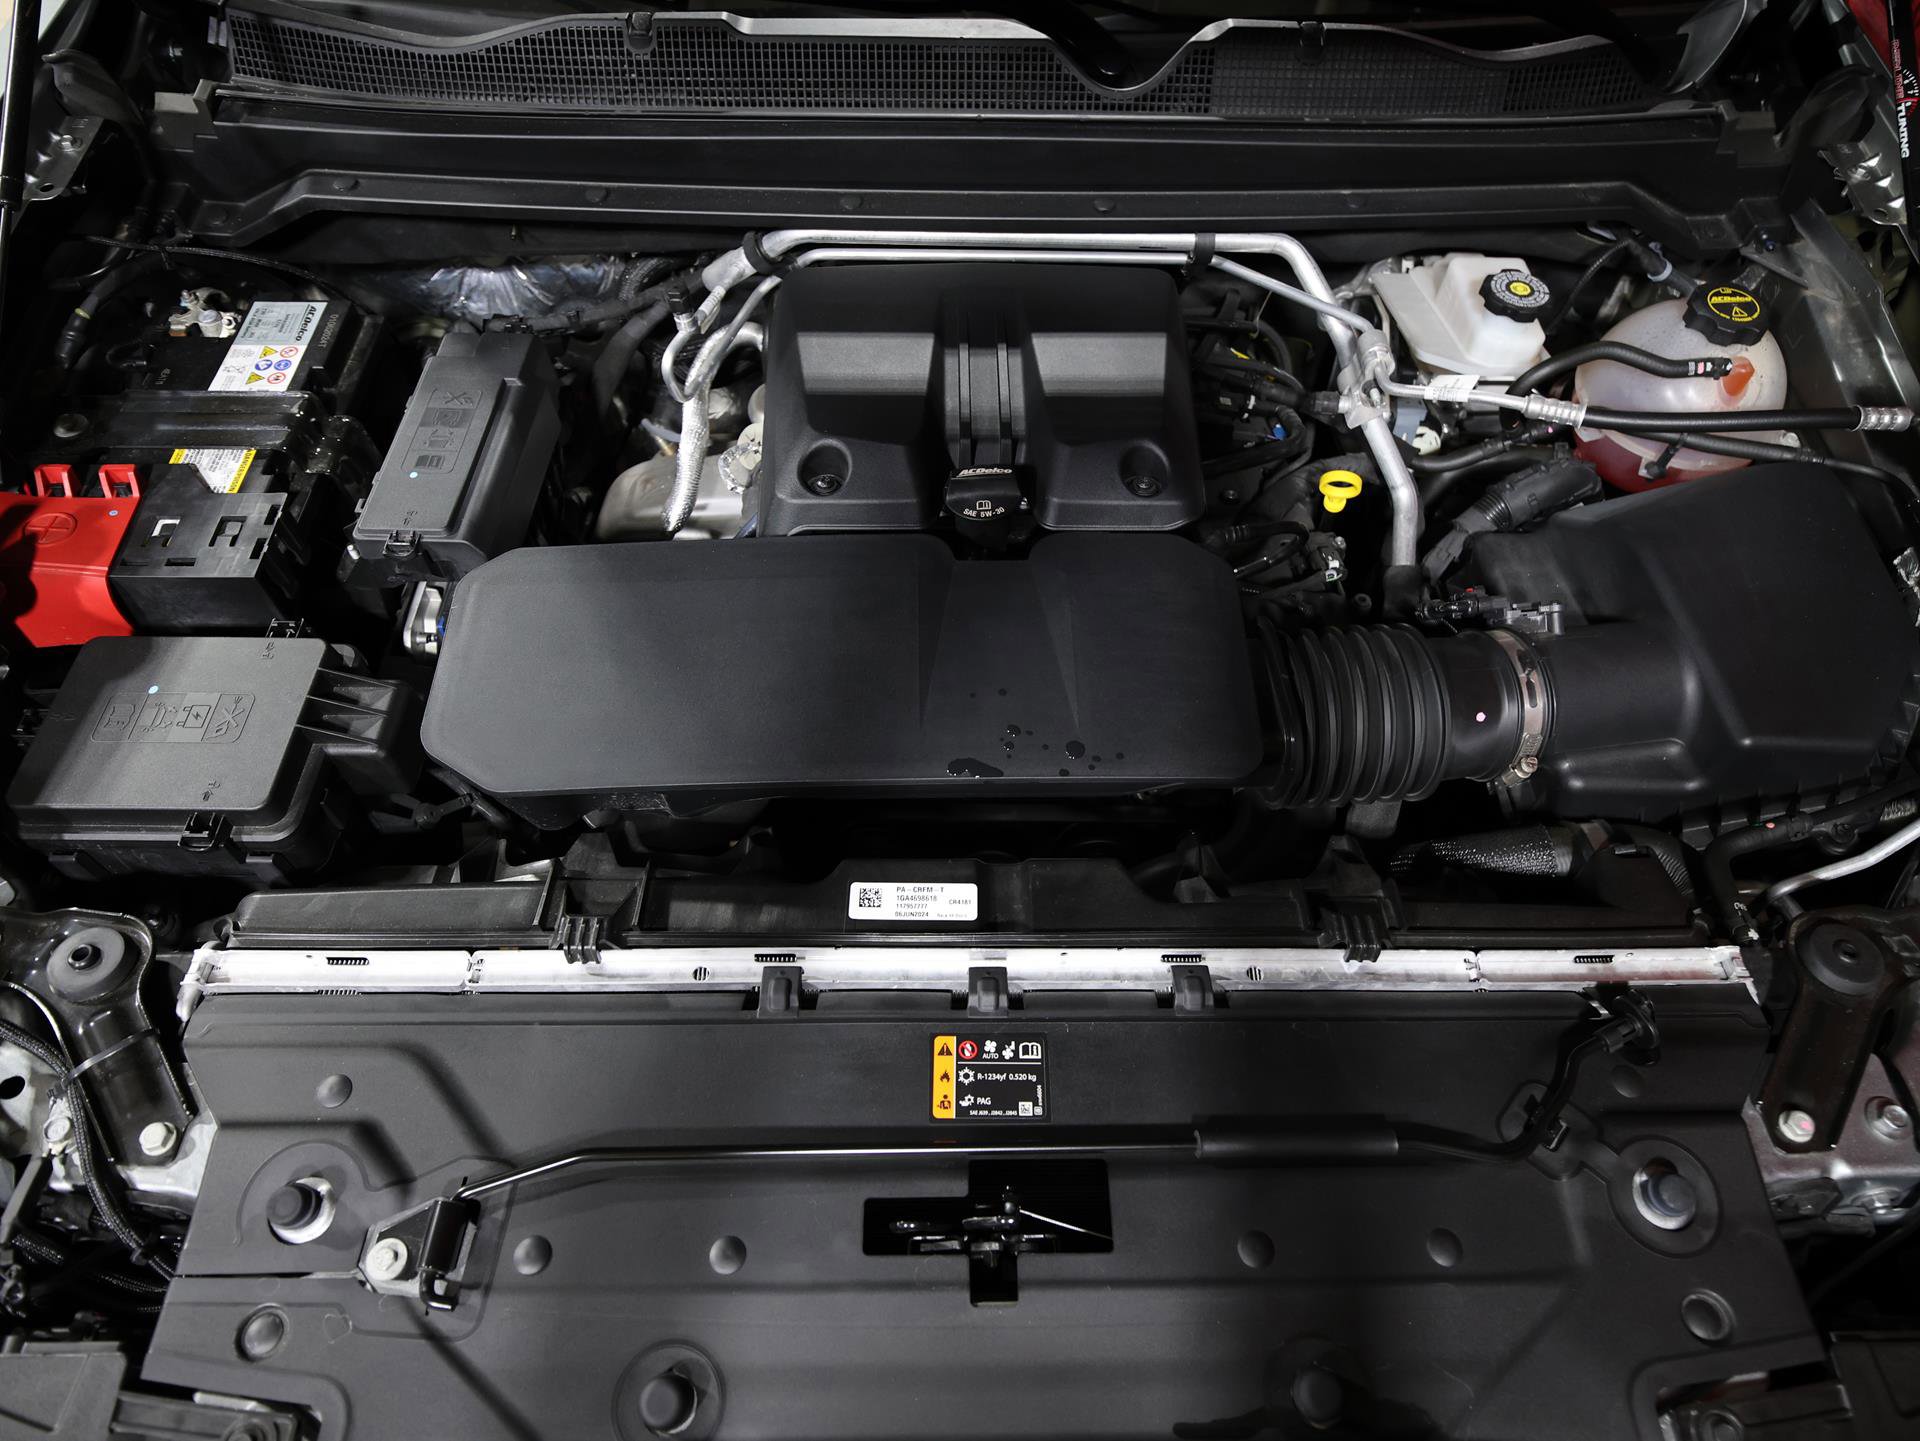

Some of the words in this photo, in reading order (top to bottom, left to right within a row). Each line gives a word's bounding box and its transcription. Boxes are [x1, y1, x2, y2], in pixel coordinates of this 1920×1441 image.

[1897, 103, 1909, 158] TUNING
[295, 304, 318, 342] ACDelco
[956, 467, 1013, 477] ACDelco
[963, 508, 978, 518] SAE
[980, 506, 1005, 518] 5W-30
[977, 1073, 1006, 1082] R-1234yf
[1008, 1073, 1028, 1081] 0.520
[1028, 1073, 1037, 1082] kg
[976, 1097, 992, 1105] PAG
